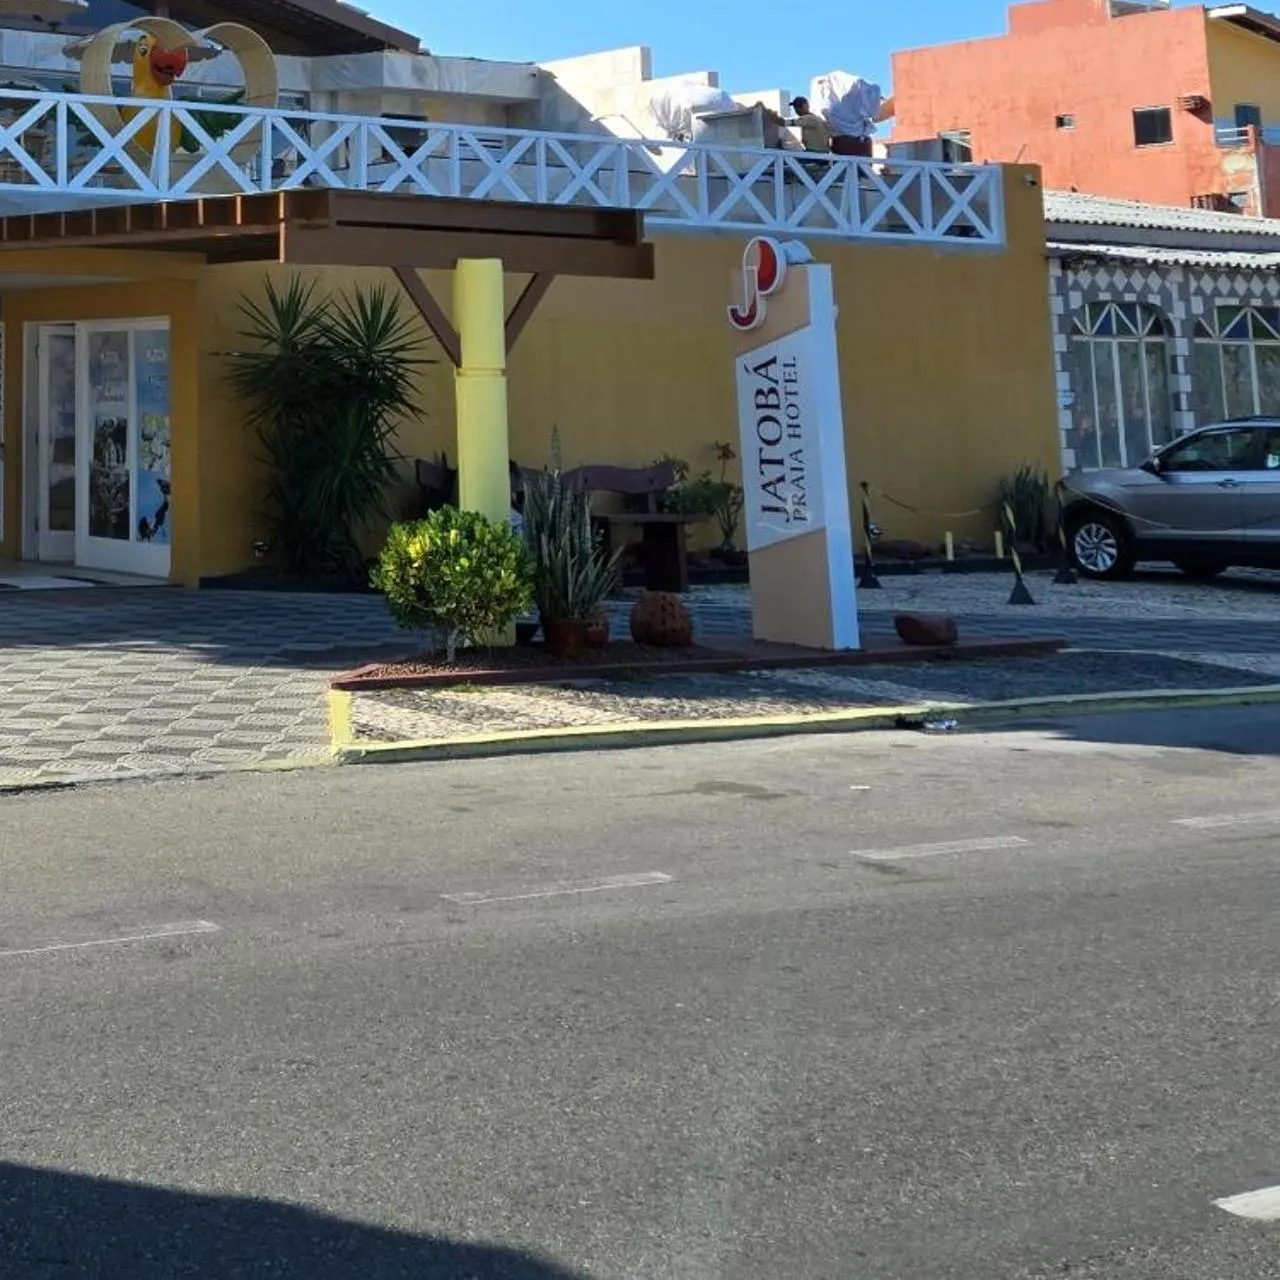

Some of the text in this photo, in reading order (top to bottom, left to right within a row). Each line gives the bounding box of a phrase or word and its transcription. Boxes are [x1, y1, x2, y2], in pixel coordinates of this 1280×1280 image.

[744, 355, 788, 523] JATOBÁ
[783, 356, 809, 522] PRAIA HOTEL
